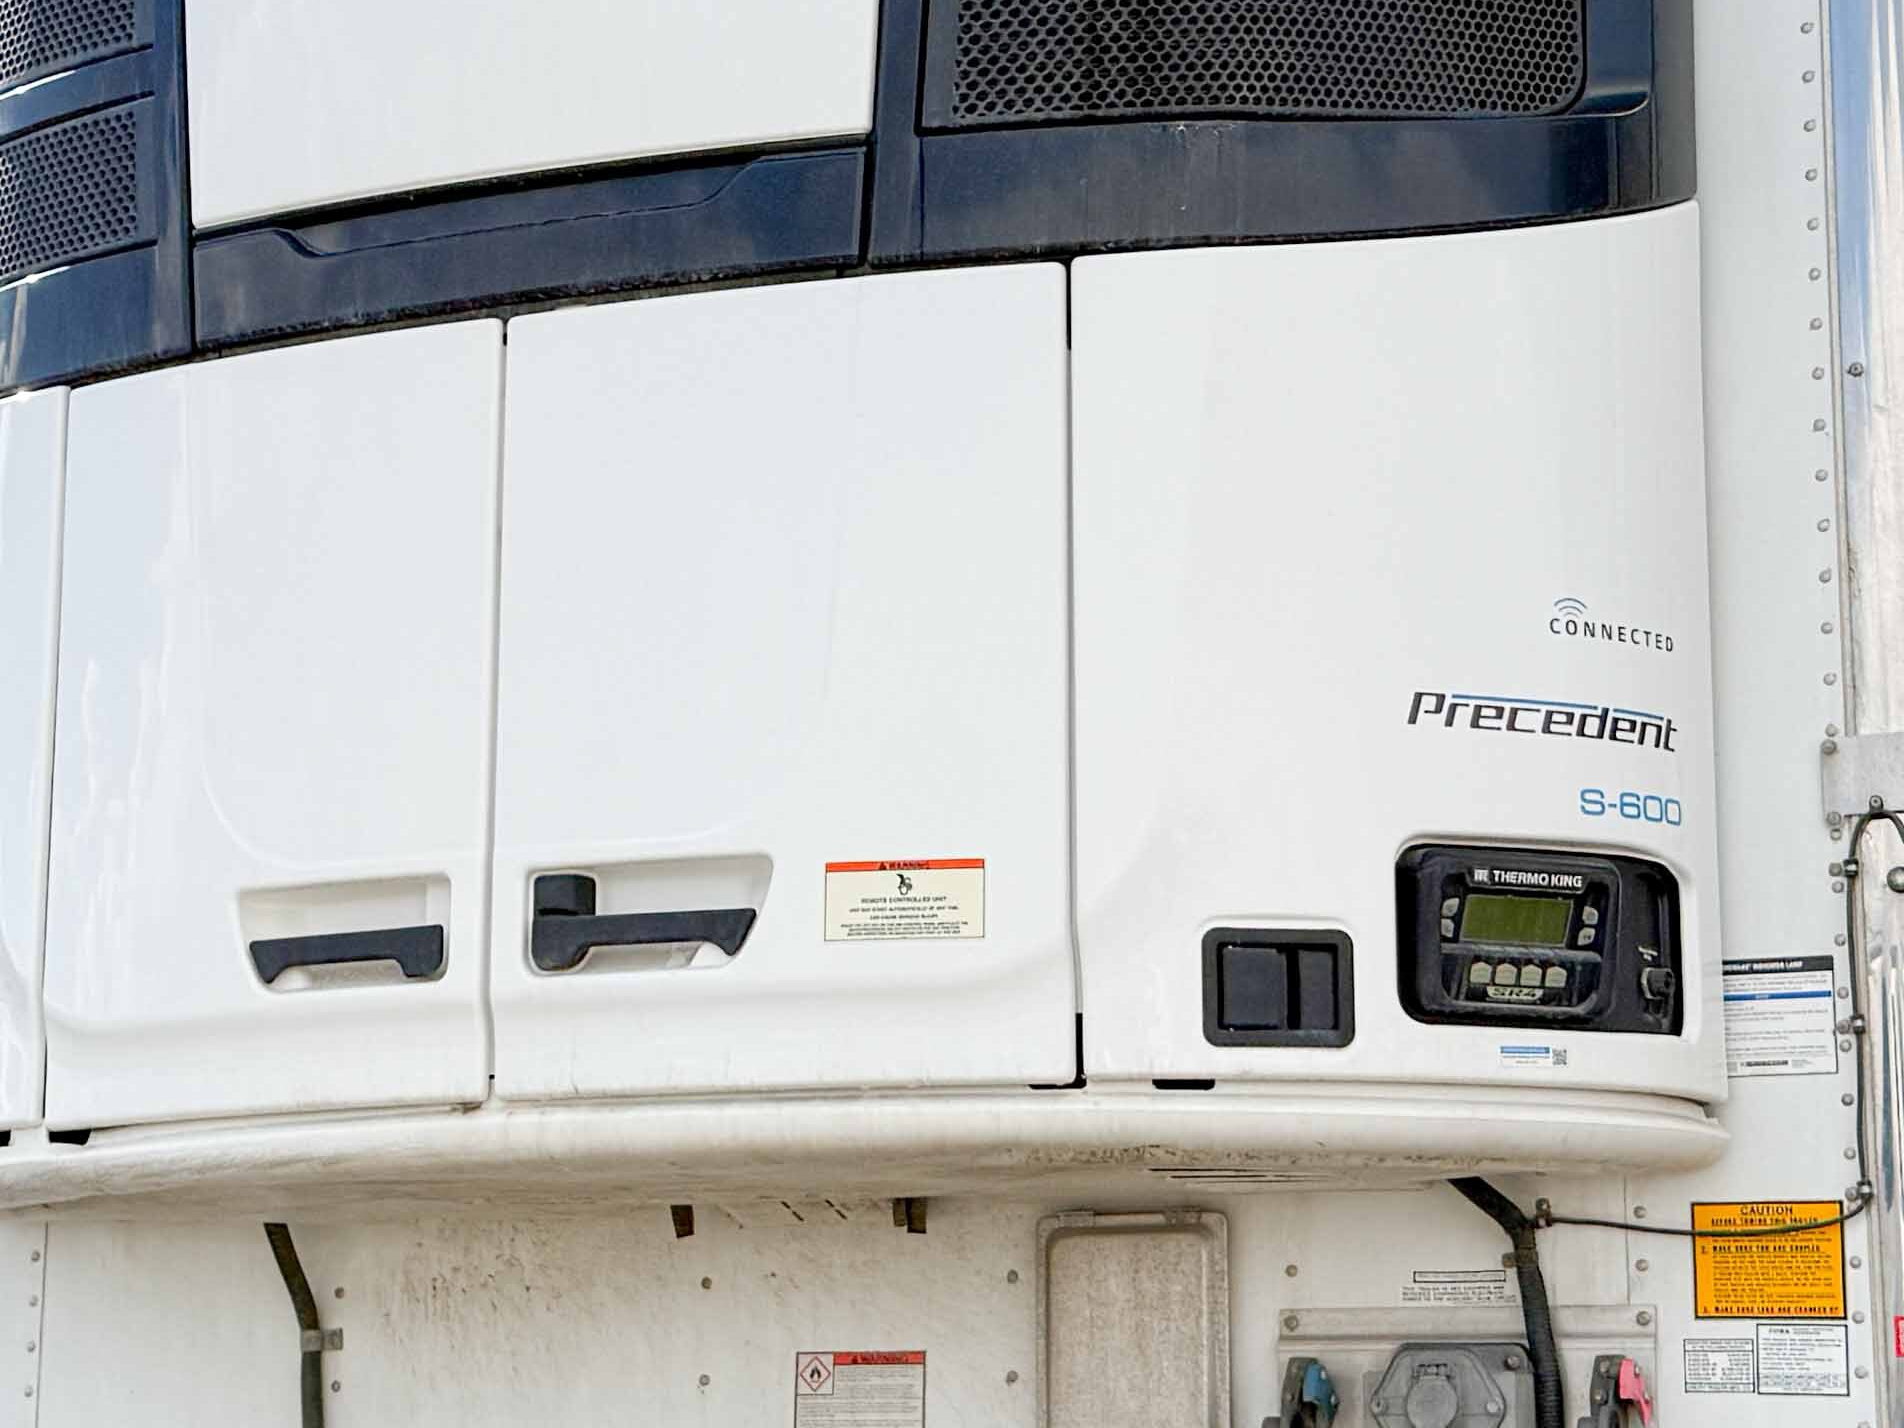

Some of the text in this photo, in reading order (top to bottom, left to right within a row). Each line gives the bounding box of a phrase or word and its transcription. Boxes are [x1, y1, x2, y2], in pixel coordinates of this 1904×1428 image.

[1549, 618, 1674, 653] CONNECTED
[1407, 690, 1678, 752] Precedent
[1579, 788, 1683, 827] S-600
[1493, 870, 1548, 886] THERMO
[1551, 873, 1583, 888] KING
[1740, 1205, 1793, 1215] CAUTION
